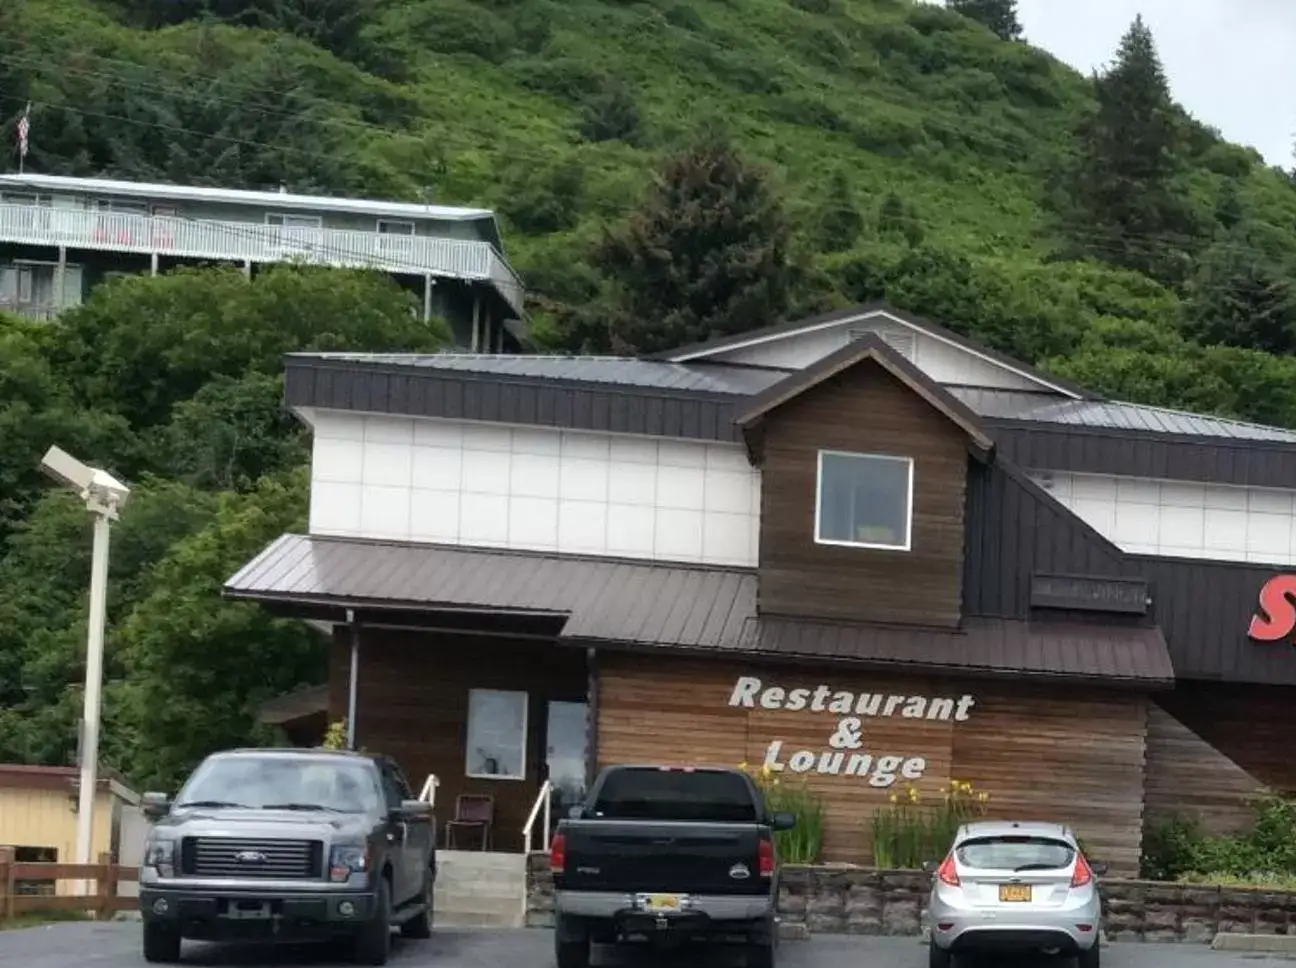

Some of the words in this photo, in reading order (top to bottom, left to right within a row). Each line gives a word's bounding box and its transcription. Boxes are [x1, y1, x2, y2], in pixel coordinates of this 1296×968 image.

[728, 676, 975, 721] Restaurant
[828, 716, 863, 749] &
[764, 740, 926, 787] Lounge
